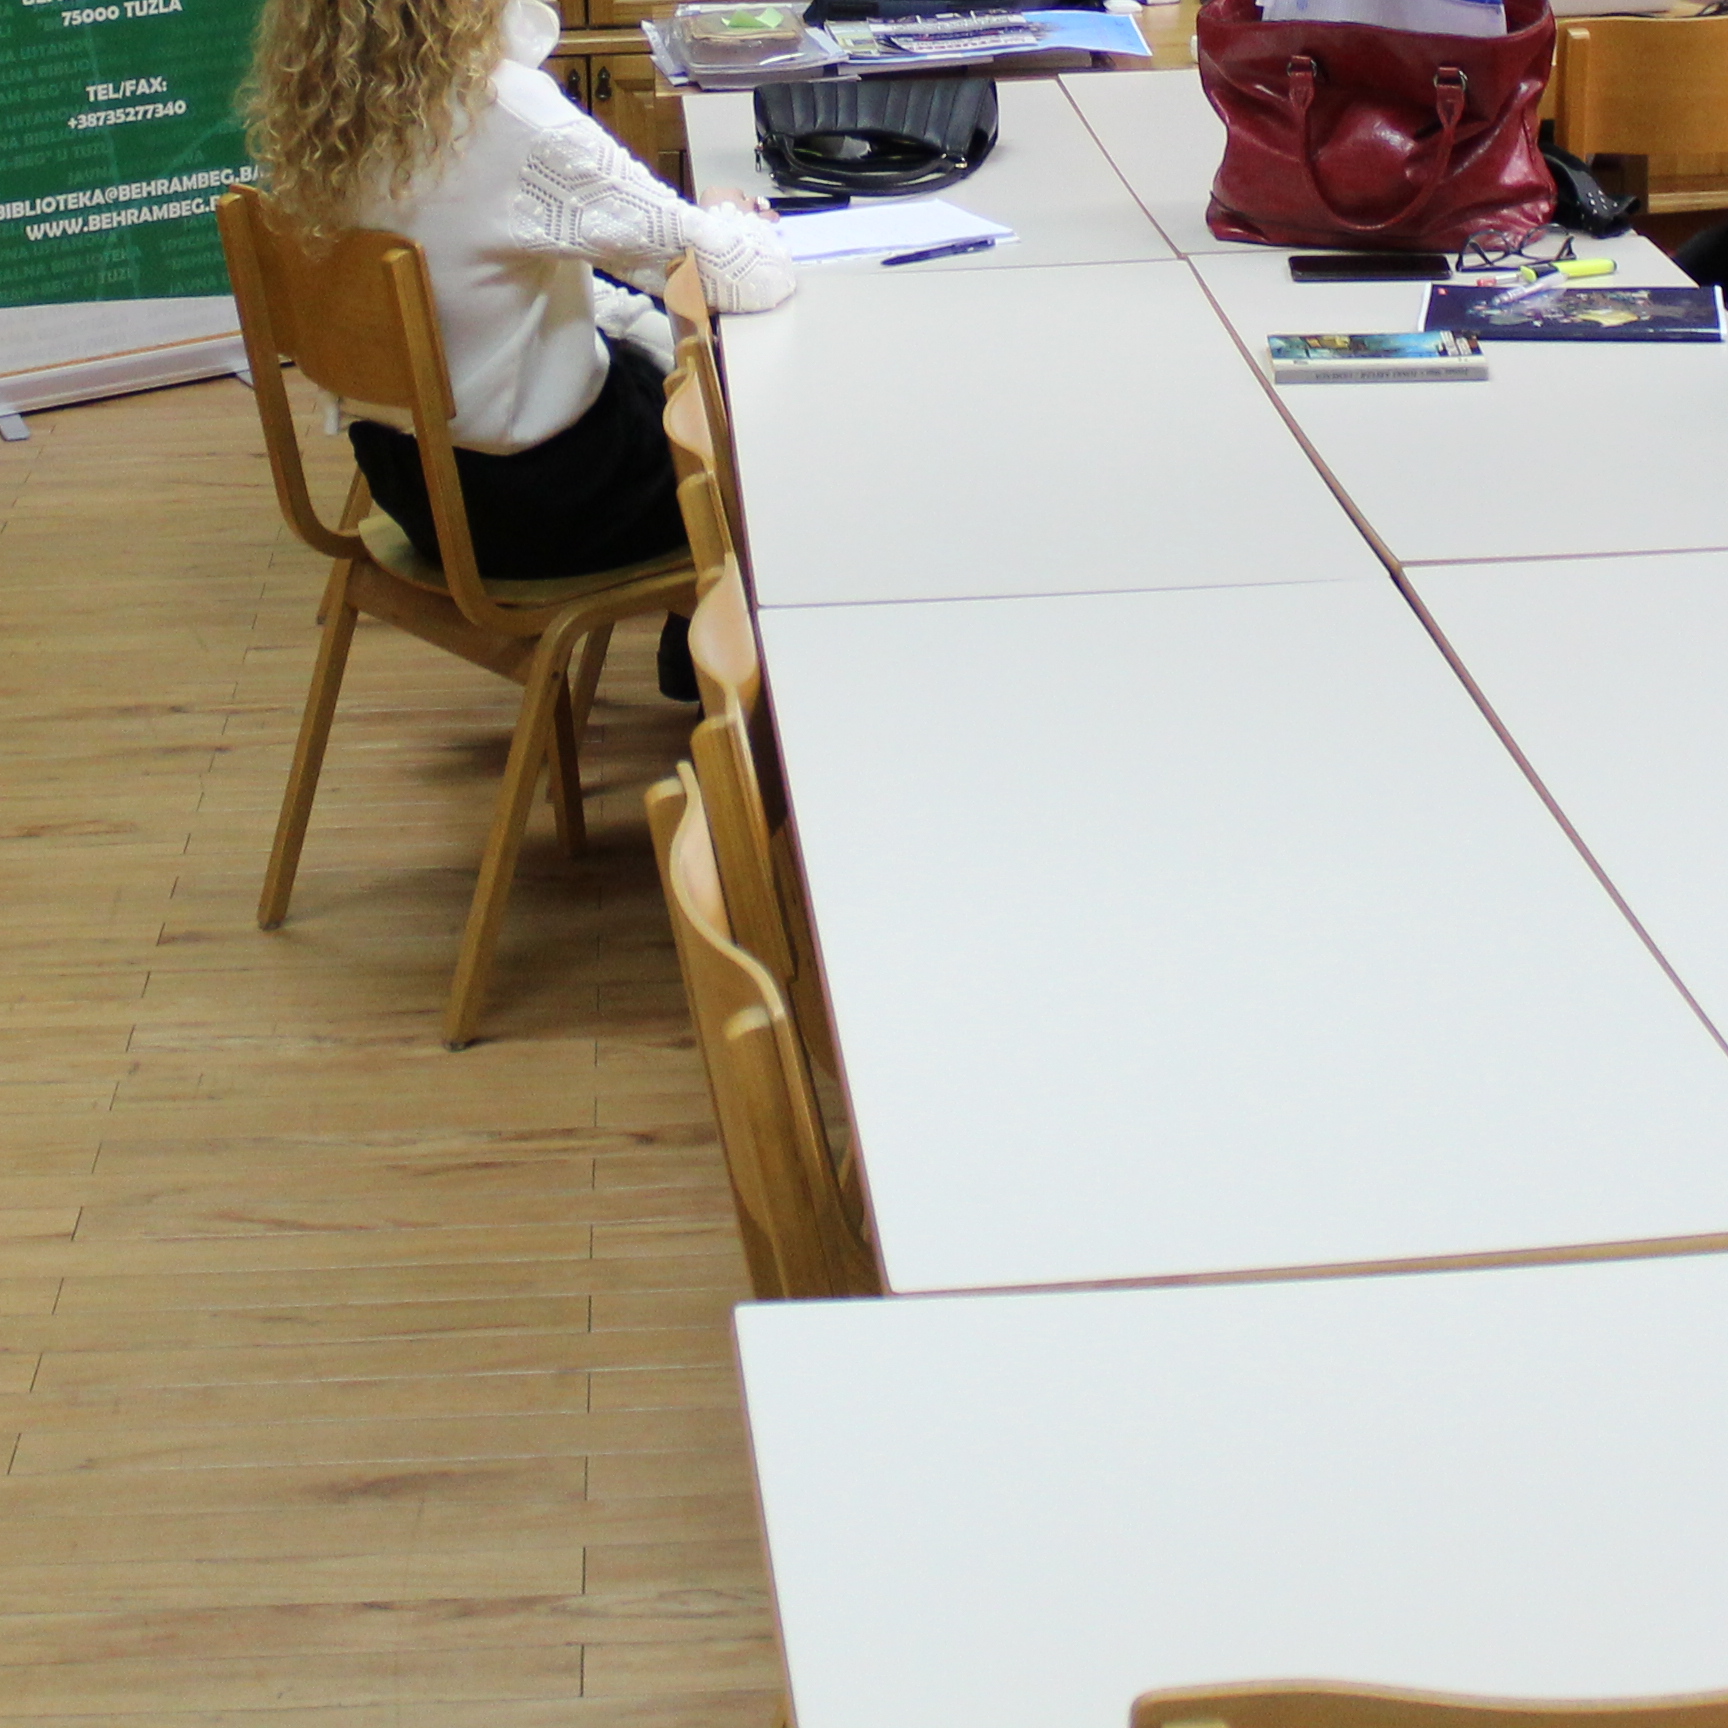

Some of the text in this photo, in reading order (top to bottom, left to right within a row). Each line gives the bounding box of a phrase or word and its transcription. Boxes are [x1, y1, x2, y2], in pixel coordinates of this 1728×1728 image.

[61, 5, 119, 27] 75000
[86, 75, 167, 103] TEL/FAX:
[68, 99, 186, 130] +38735277340
[26, 195, 219, 242] WWW.BEHRAMBEG.B
